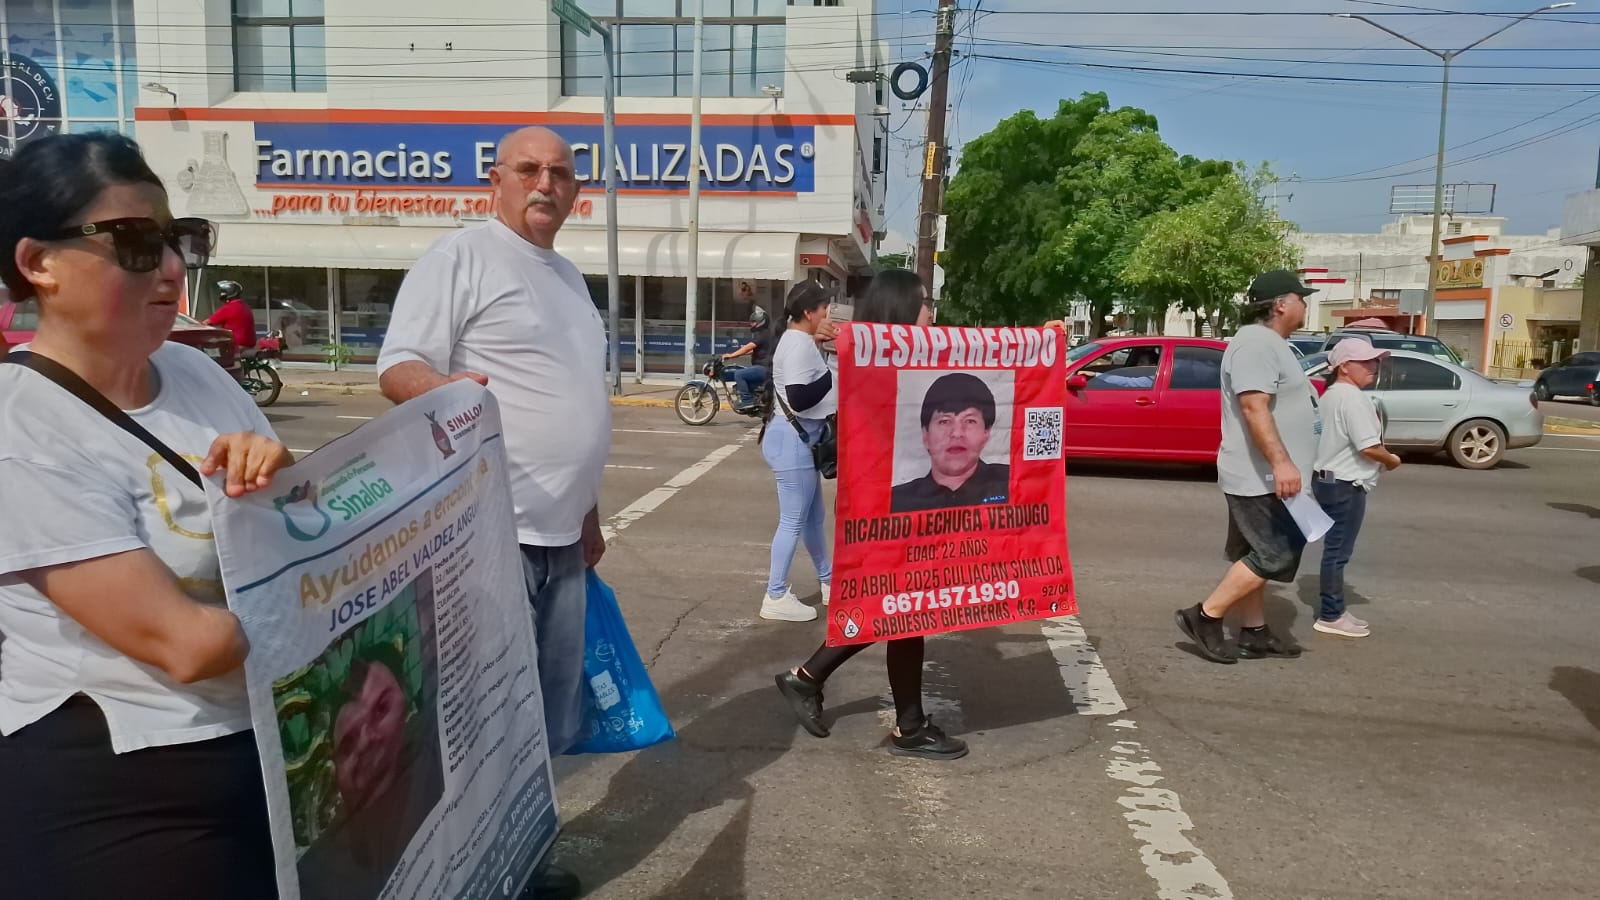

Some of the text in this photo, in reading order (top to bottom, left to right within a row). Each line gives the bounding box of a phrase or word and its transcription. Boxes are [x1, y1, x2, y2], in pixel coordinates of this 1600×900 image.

[254, 140, 452, 179] Farmacias
[327, 192, 349, 213] tu
[850, 323, 1057, 368] DESAPARECIDO
[327, 477, 393, 521] Sinaloa
[844, 503, 1050, 545] RICARDO LECHUGA VERDUGO
[299, 519, 418, 610] Ayúdanos
[906, 537, 988, 564] EDAD: 22 AÑOS
[329, 586, 377, 632] JOSE
[381, 560, 411, 602] ABEL
[413, 524, 455, 569] VALDEZ
[840, 556, 1064, 600] 28 ABRIL 2025 CULIACAN SINALOA
[882, 580, 1020, 615] 6671571930
[1042, 583, 1069, 597] 92/04
[873, 613, 938, 638] SABUESOS
[940, 601, 1016, 629] GUERRERAS,
